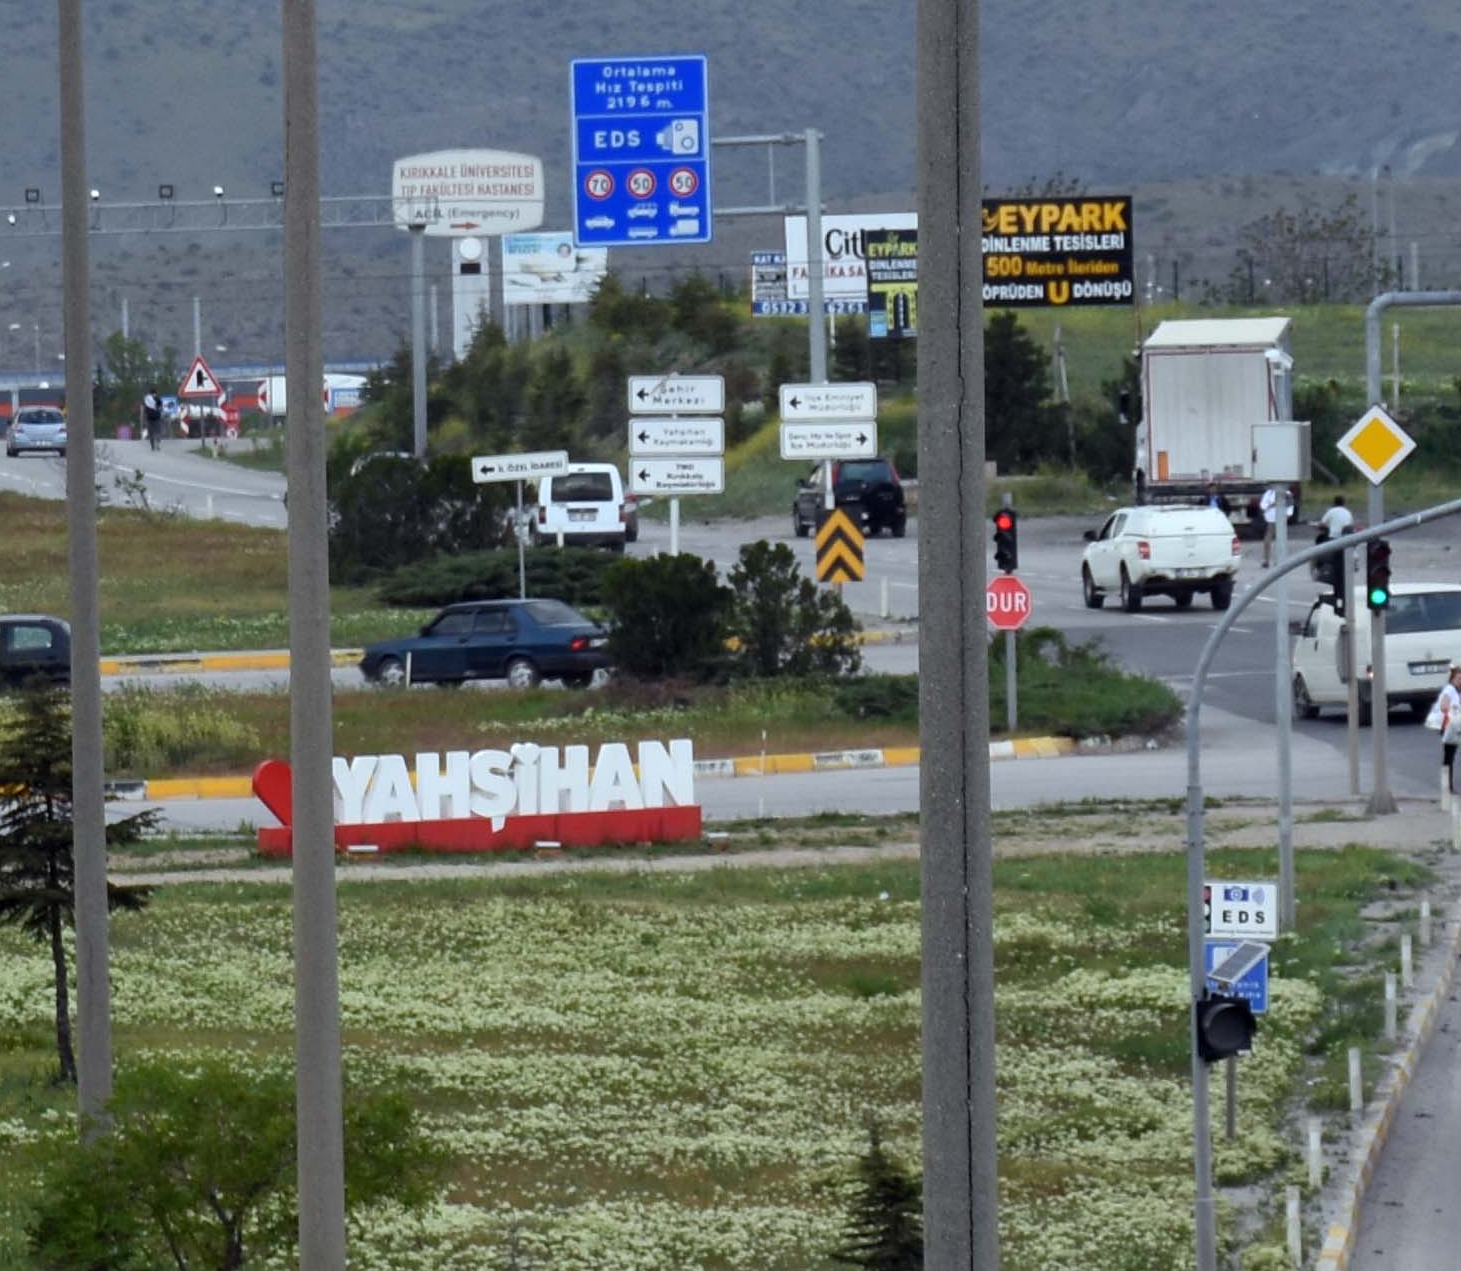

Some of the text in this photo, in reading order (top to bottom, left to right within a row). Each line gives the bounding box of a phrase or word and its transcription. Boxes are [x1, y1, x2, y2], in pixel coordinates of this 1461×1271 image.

[603, 66, 676, 78] Ortalama
[595, 80, 683, 94] Hız Tespiti
[594, 131, 641, 148] EDS
[400, 163, 535, 178] KIRIKKALE ÜNİVERSİTESİ
[401, 182, 535, 196] TIP FAKÜLTESİ HASTANESİ
[591, 179, 609, 191] 70
[633, 178, 650, 190] 50
[675, 177, 694, 190] 50
[447, 208, 520, 222] (Emergency)
[982, 233, 1125, 253] DİNLENME TESİSLERİ
[987, 256, 1022, 276] 500
[1026, 261, 1065, 276] Metre
[982, 280, 1132, 304] ÖPRÜDEN U DÖNÜŞÜ
[987, 591, 1027, 612] DUR
[332, 740, 694, 833] YAHŞİHAN
[1222, 910, 1266, 924] EDS
